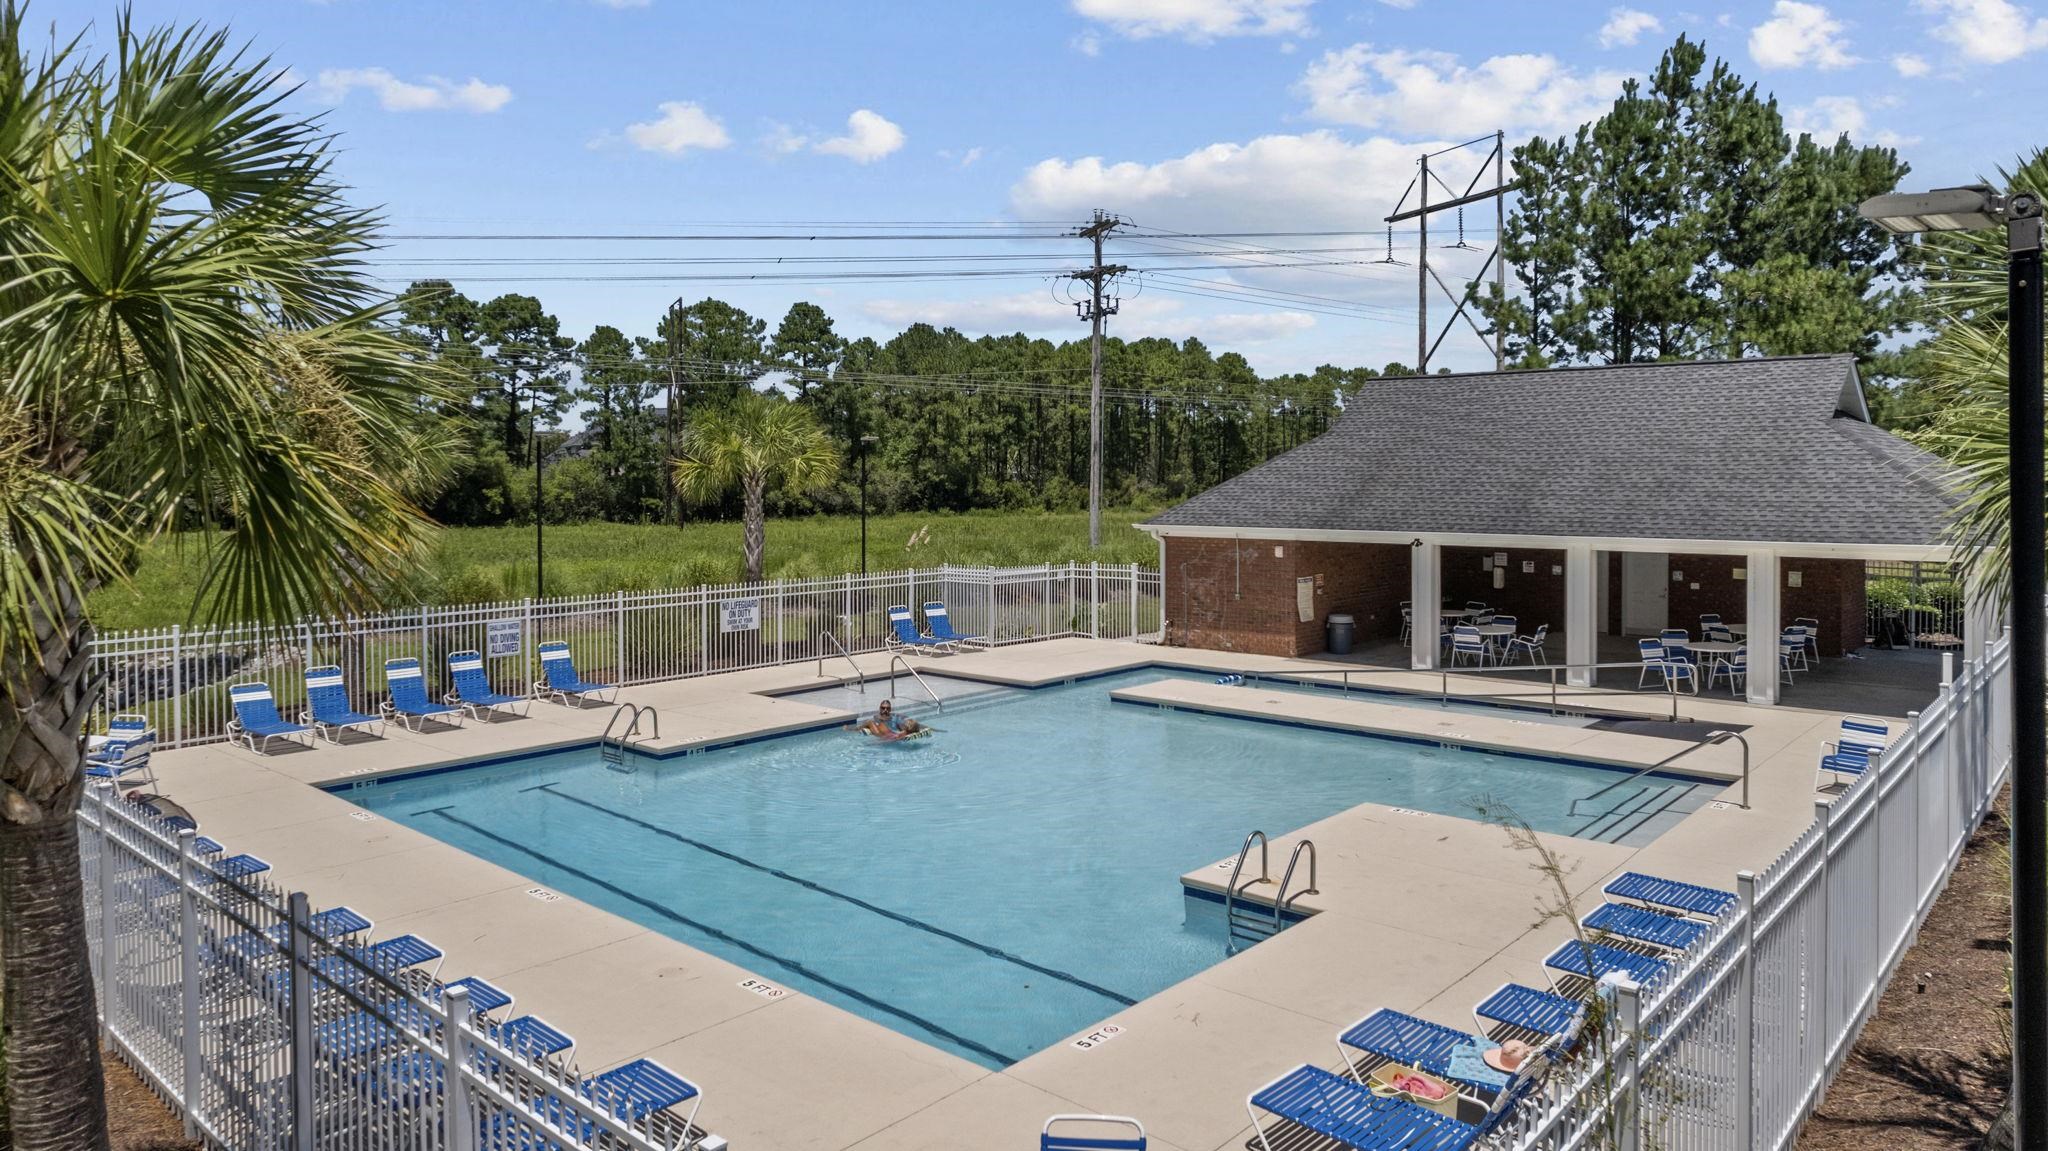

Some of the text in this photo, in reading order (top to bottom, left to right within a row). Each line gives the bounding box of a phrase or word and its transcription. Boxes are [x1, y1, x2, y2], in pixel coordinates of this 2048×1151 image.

[722, 600, 758, 610] NO LIFEGUARD
[729, 609, 751, 618] ON DUTY
[490, 632, 519, 643] NO DIVING
[491, 643, 518, 654] ALLOWED
[742, 979, 771, 993] 5 FT
[1076, 1031, 1107, 1048] 5 FT
